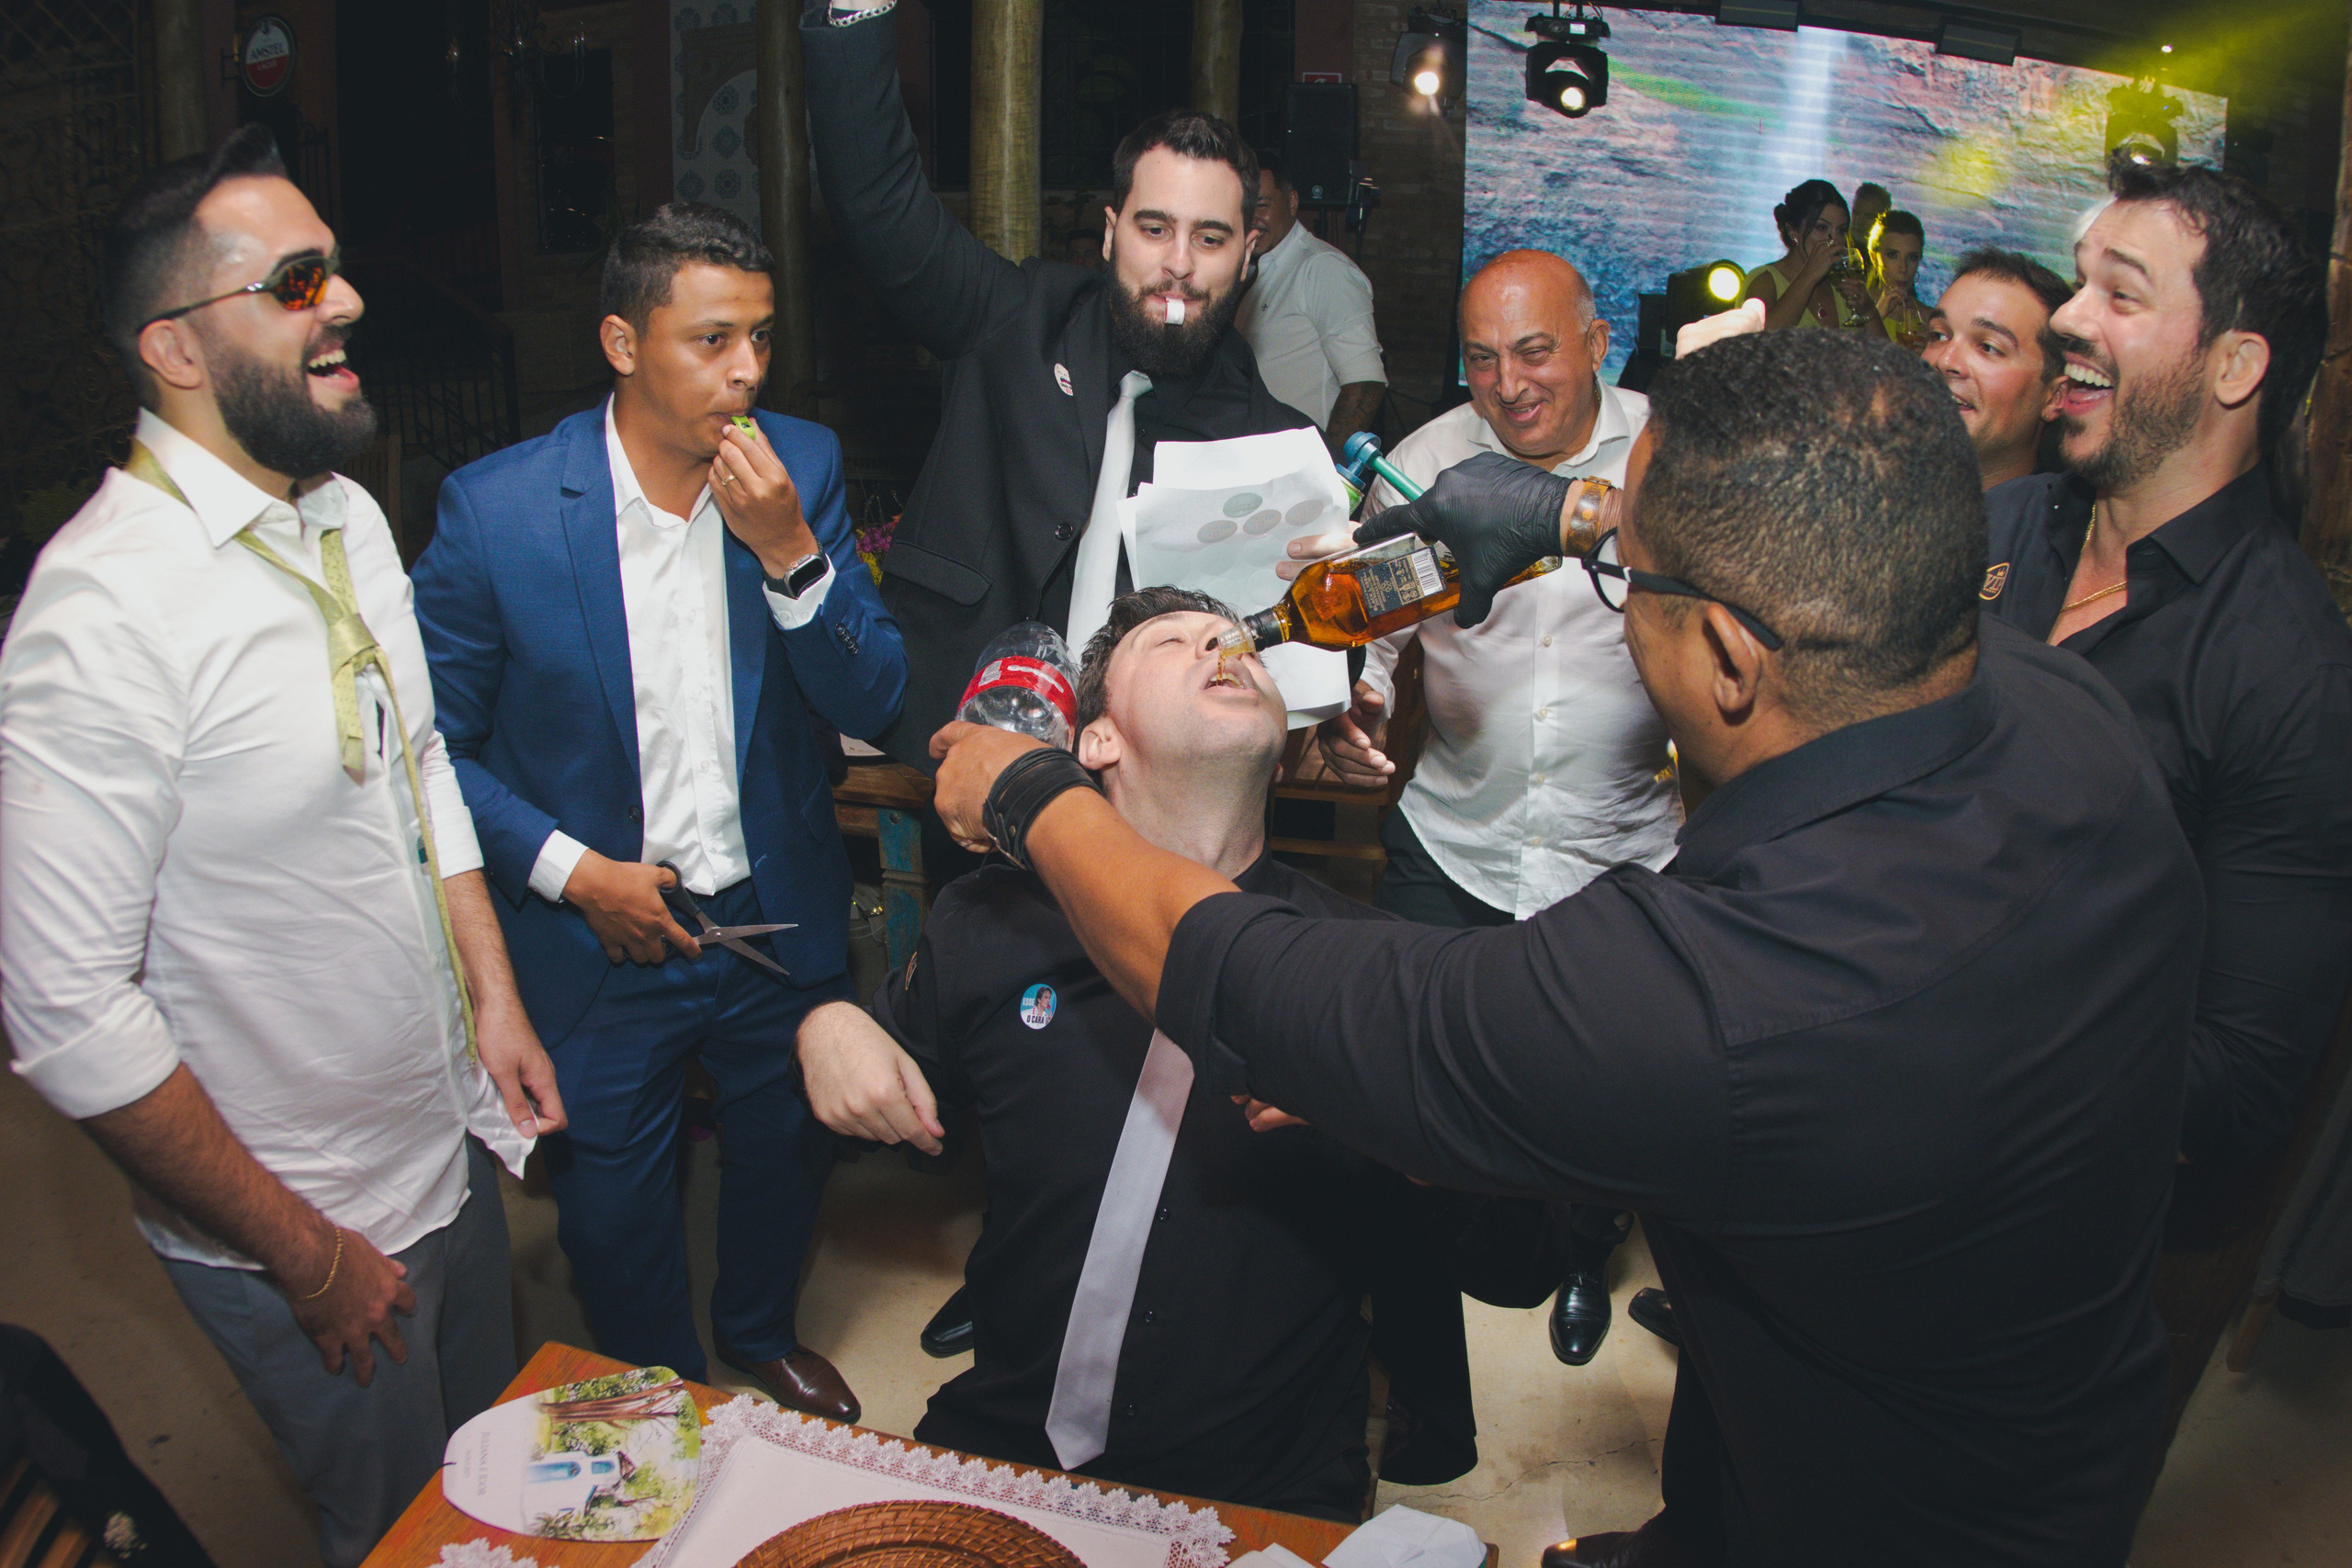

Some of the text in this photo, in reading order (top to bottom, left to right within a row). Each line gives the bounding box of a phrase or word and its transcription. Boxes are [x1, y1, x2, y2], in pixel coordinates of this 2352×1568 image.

[1023, 998, 1035, 1006] ESSE
[1026, 1014, 1045, 1024] O CARA
